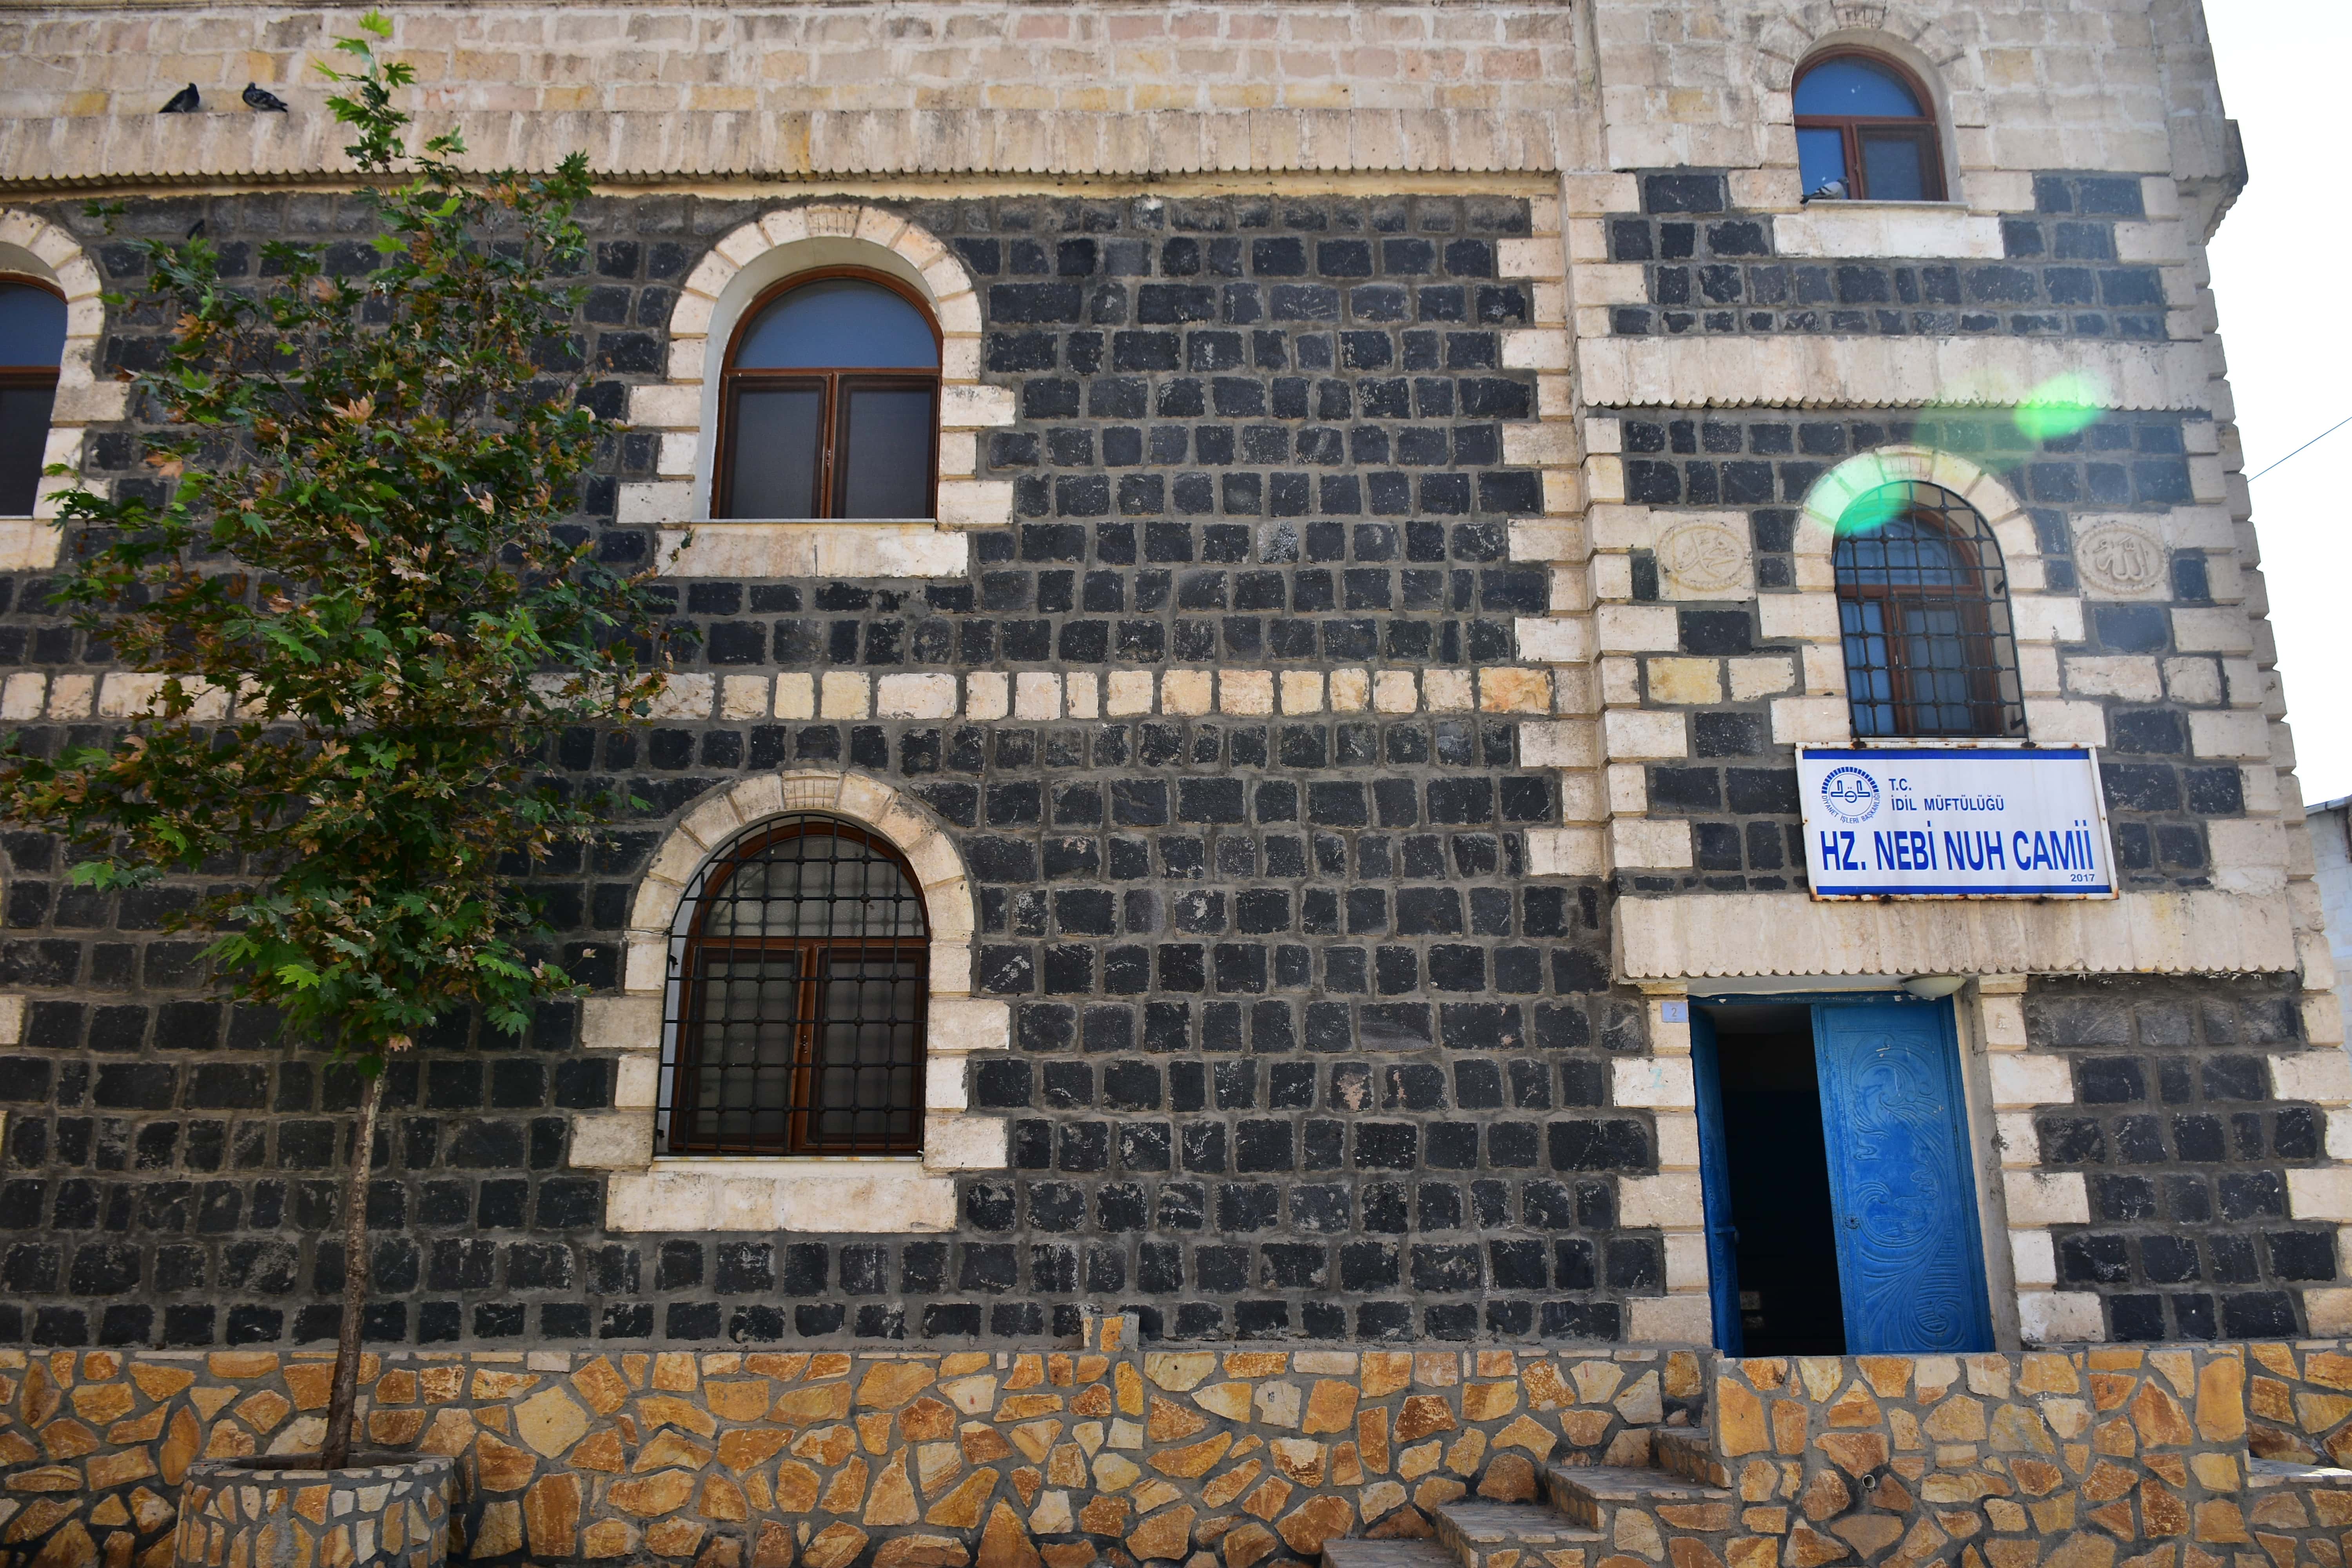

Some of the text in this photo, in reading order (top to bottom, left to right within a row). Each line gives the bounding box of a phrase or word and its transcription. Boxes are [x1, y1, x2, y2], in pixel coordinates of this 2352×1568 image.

[1888, 778, 1912, 791] T.C.
[1822, 795, 1839, 817] DİYANET
[1861, 793, 1880, 822] BAŞKANLIĞI
[1891, 794, 2004, 811] İDİL MÜFTÜLÜĞÜ
[1820, 819, 2094, 871] HZ. NEBİ NUH CAMİİ
[2070, 874, 2095, 882] 2017
[1671, 1007, 1677, 1017] 2
